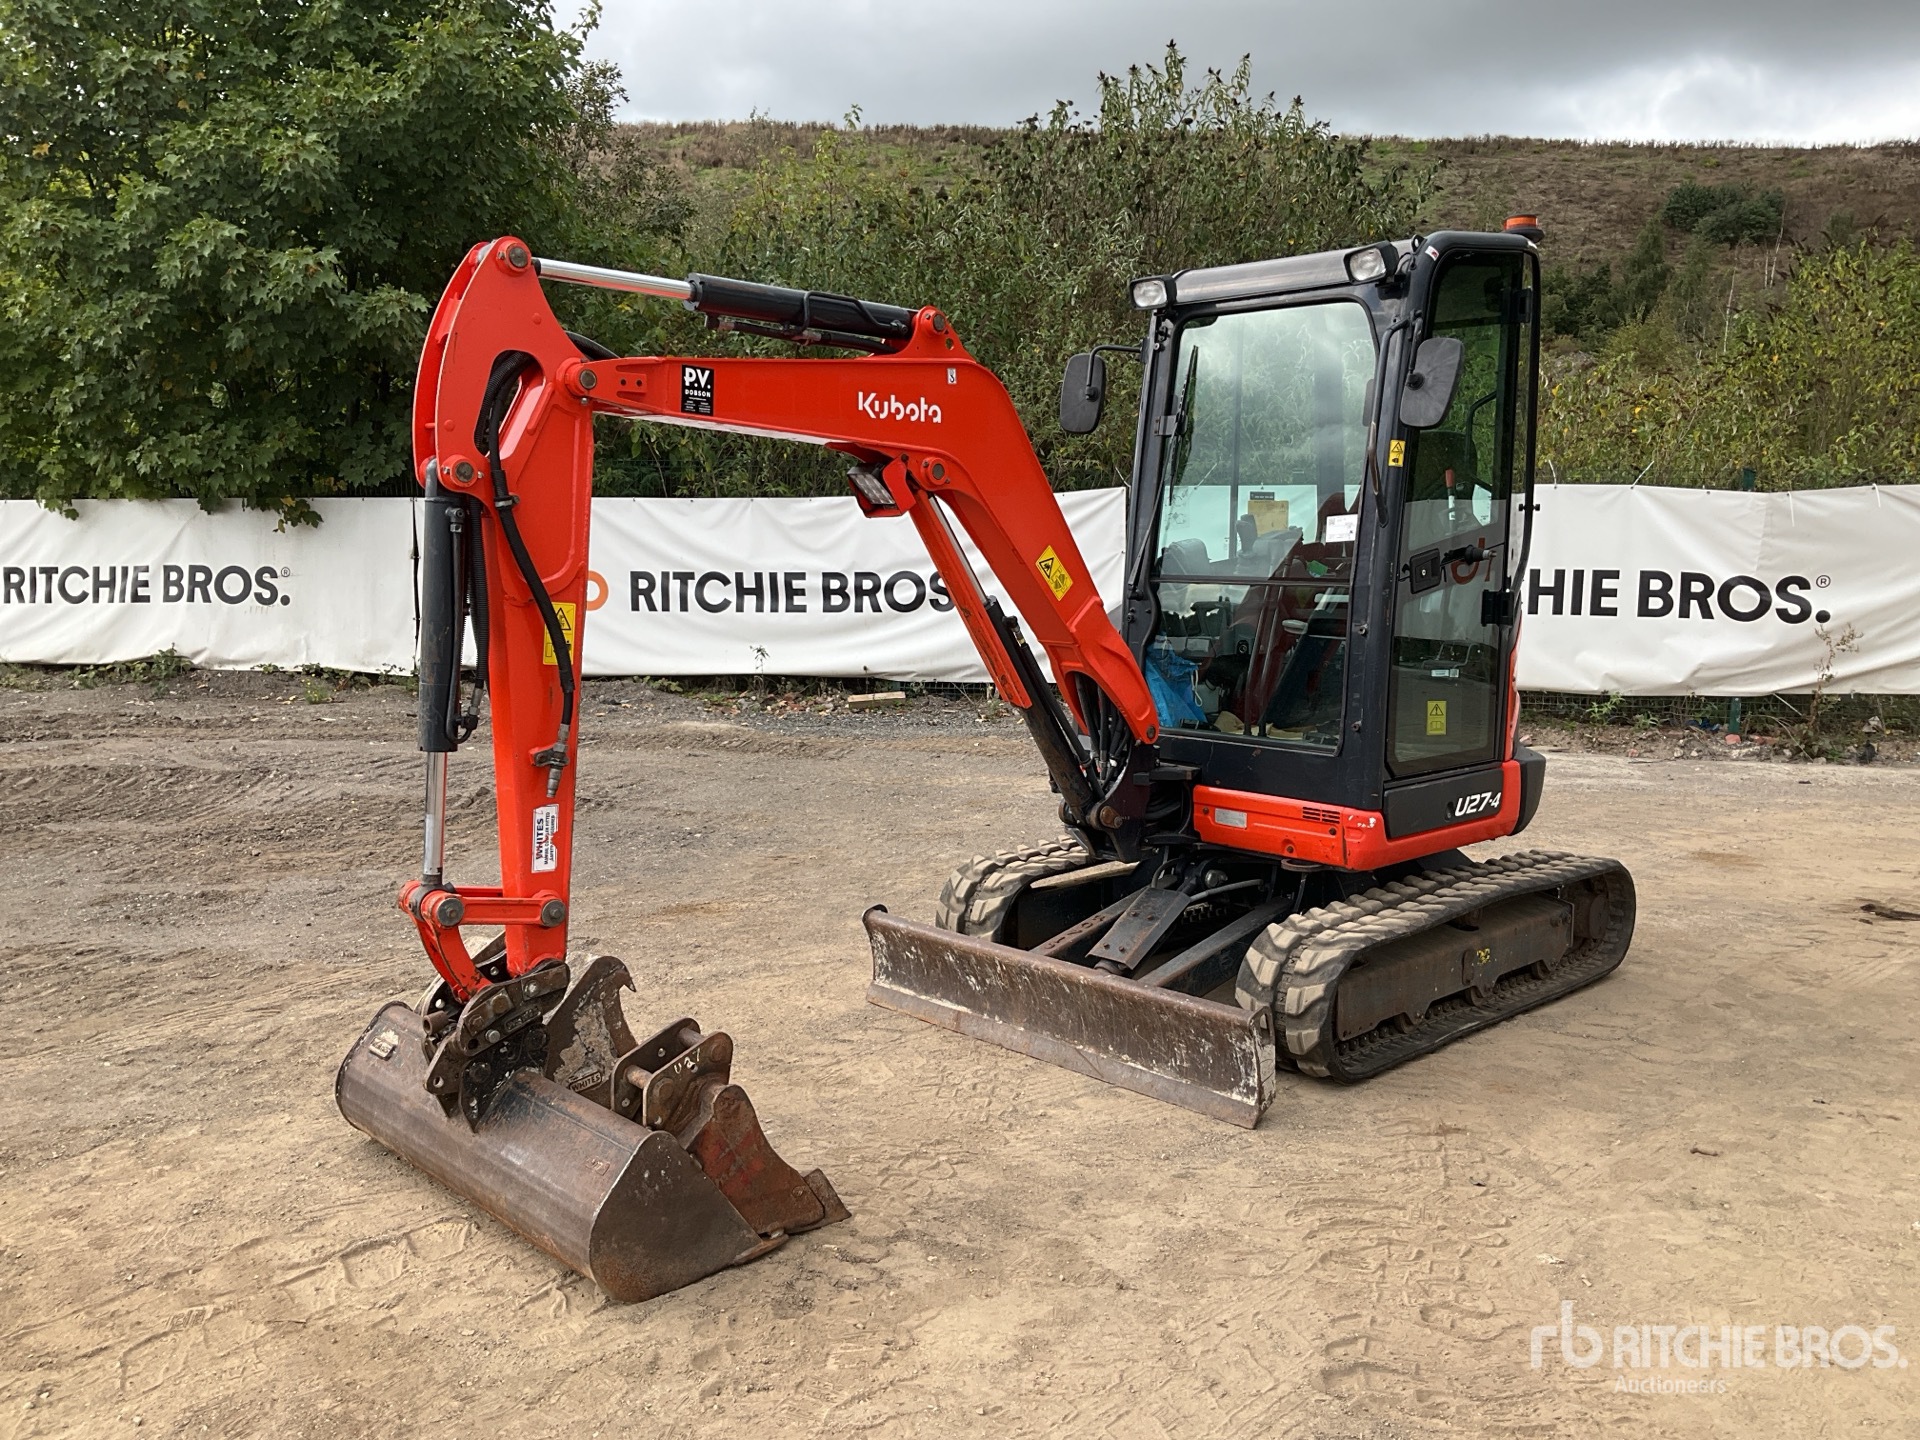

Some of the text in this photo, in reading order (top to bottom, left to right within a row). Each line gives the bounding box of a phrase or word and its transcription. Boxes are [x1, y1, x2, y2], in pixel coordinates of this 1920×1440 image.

[684, 367, 711, 389] P.V.
[684, 388, 711, 398] DOBSON
[858, 391, 942, 424] Kubota
[3, 566, 150, 604] RITCHIE
[629, 570, 807, 613] RITCHIE
[571, 1073, 600, 1091] WHITES
